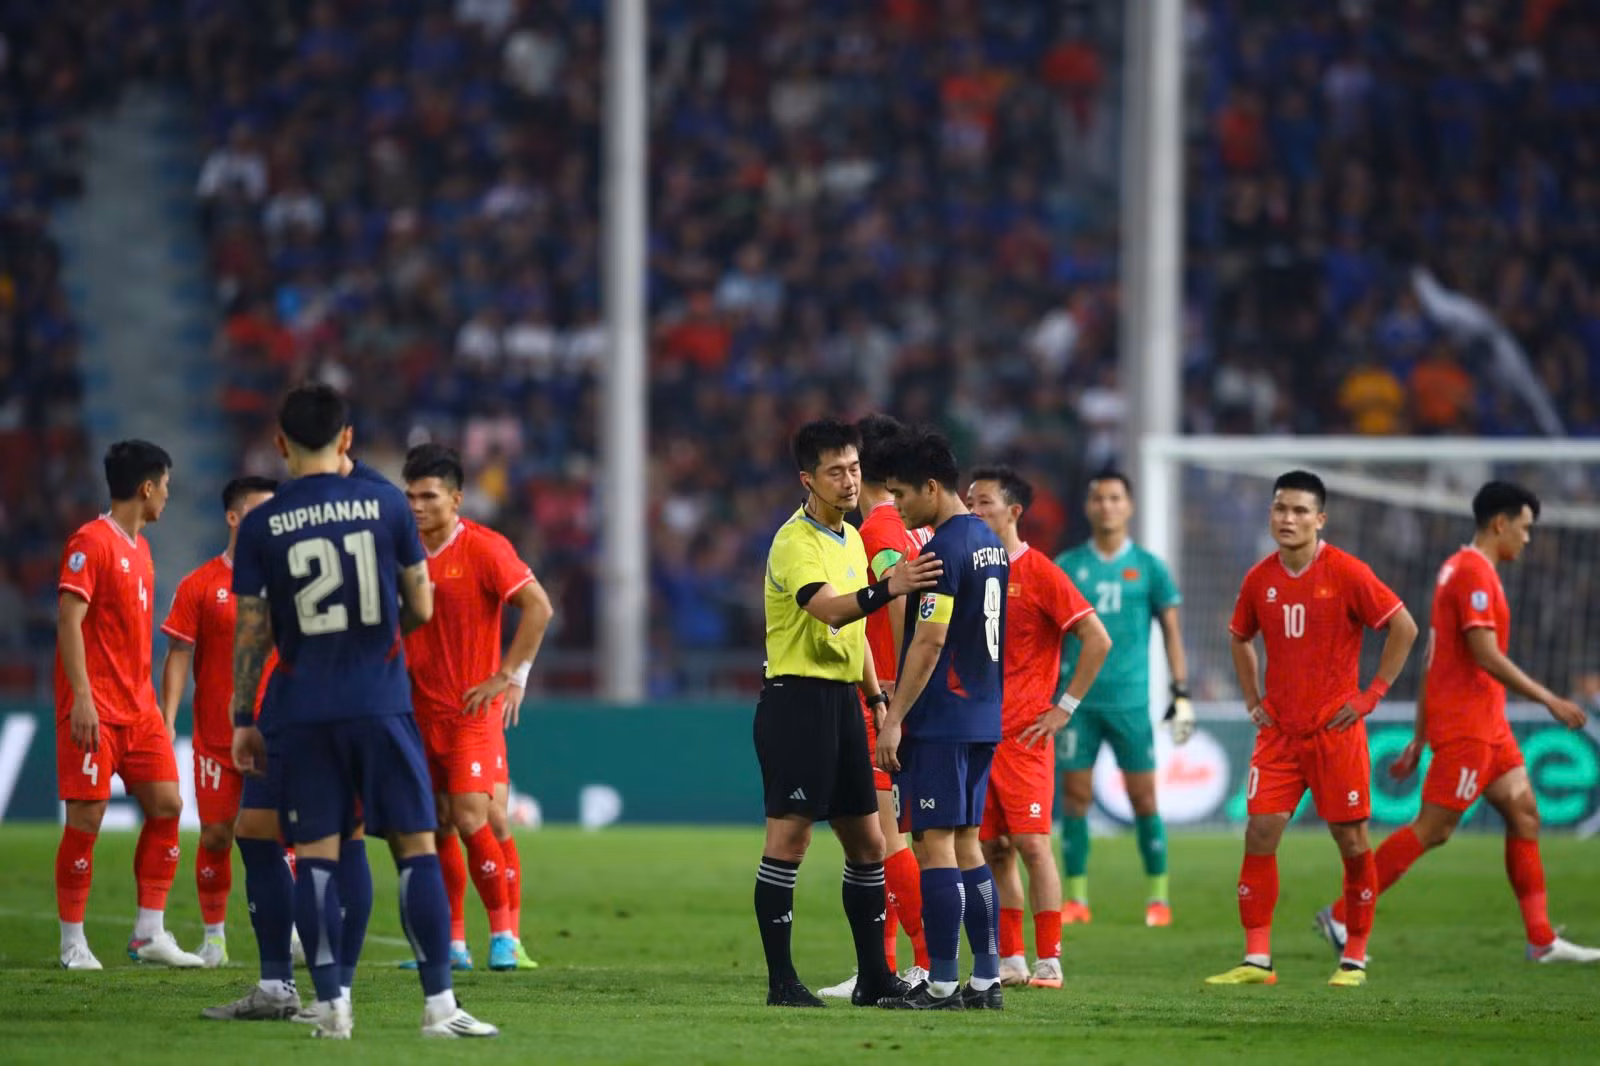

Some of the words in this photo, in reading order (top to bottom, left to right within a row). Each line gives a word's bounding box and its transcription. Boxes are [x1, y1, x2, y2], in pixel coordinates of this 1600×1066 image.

[268, 499, 380, 536] SUPHANAN
[138, 575, 148, 613] 4
[287, 529, 381, 636] 21
[1095, 581, 1121, 614] 21
[983, 577, 1001, 662] 8
[1282, 603, 1306, 639] 10
[82, 752, 98, 787] 4
[1456, 766, 1478, 801] 16
